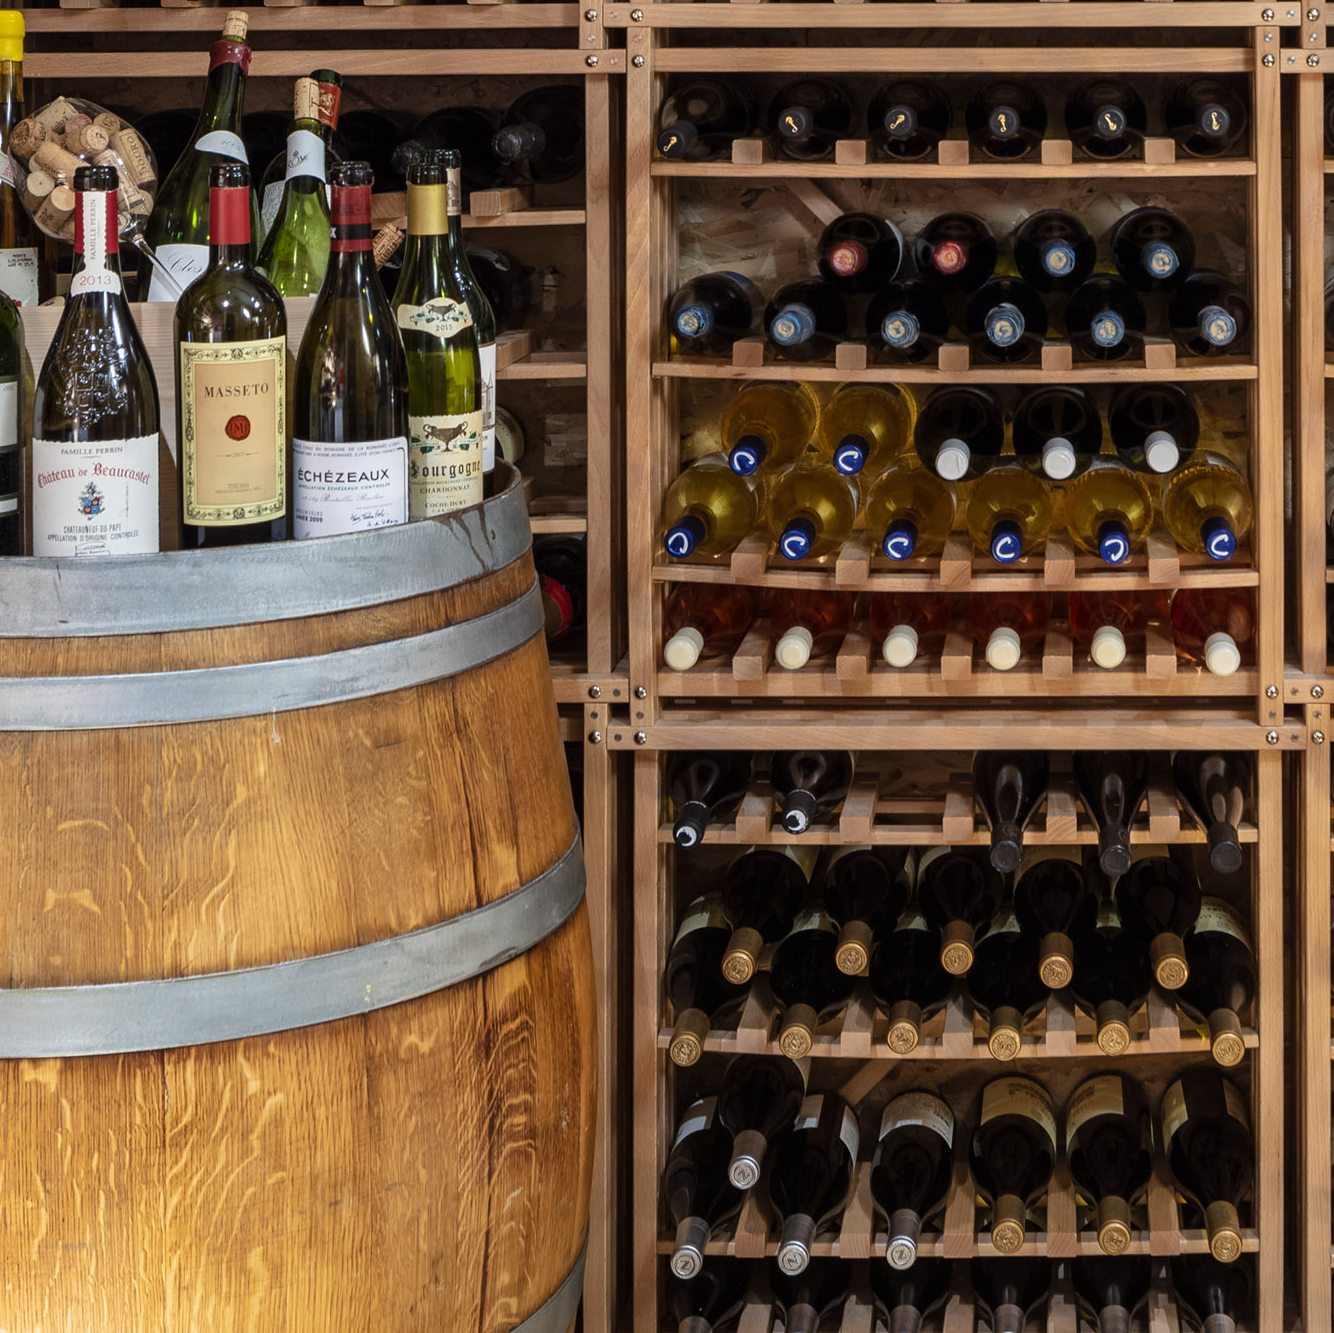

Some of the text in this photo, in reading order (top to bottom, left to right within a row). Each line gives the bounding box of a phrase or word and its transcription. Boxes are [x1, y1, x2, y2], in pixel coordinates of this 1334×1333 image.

[126, 136, 149, 177] DOURO
[167, 250, 203, 275] Clos
[79, 275, 112, 285] 2013
[435, 324, 453, 332] 2015
[204, 382, 269, 398] MASSETO
[37, 462, 150, 489] Château de Beaucastel
[298, 467, 389, 483] ÉCHÉZEAUX
[419, 485, 470, 494] CHARDONNAY
[309, 515, 323, 523] 2009
[47, 534, 77, 542] APPELLATION
[80, 533, 107, 541] D'ORIGINE
